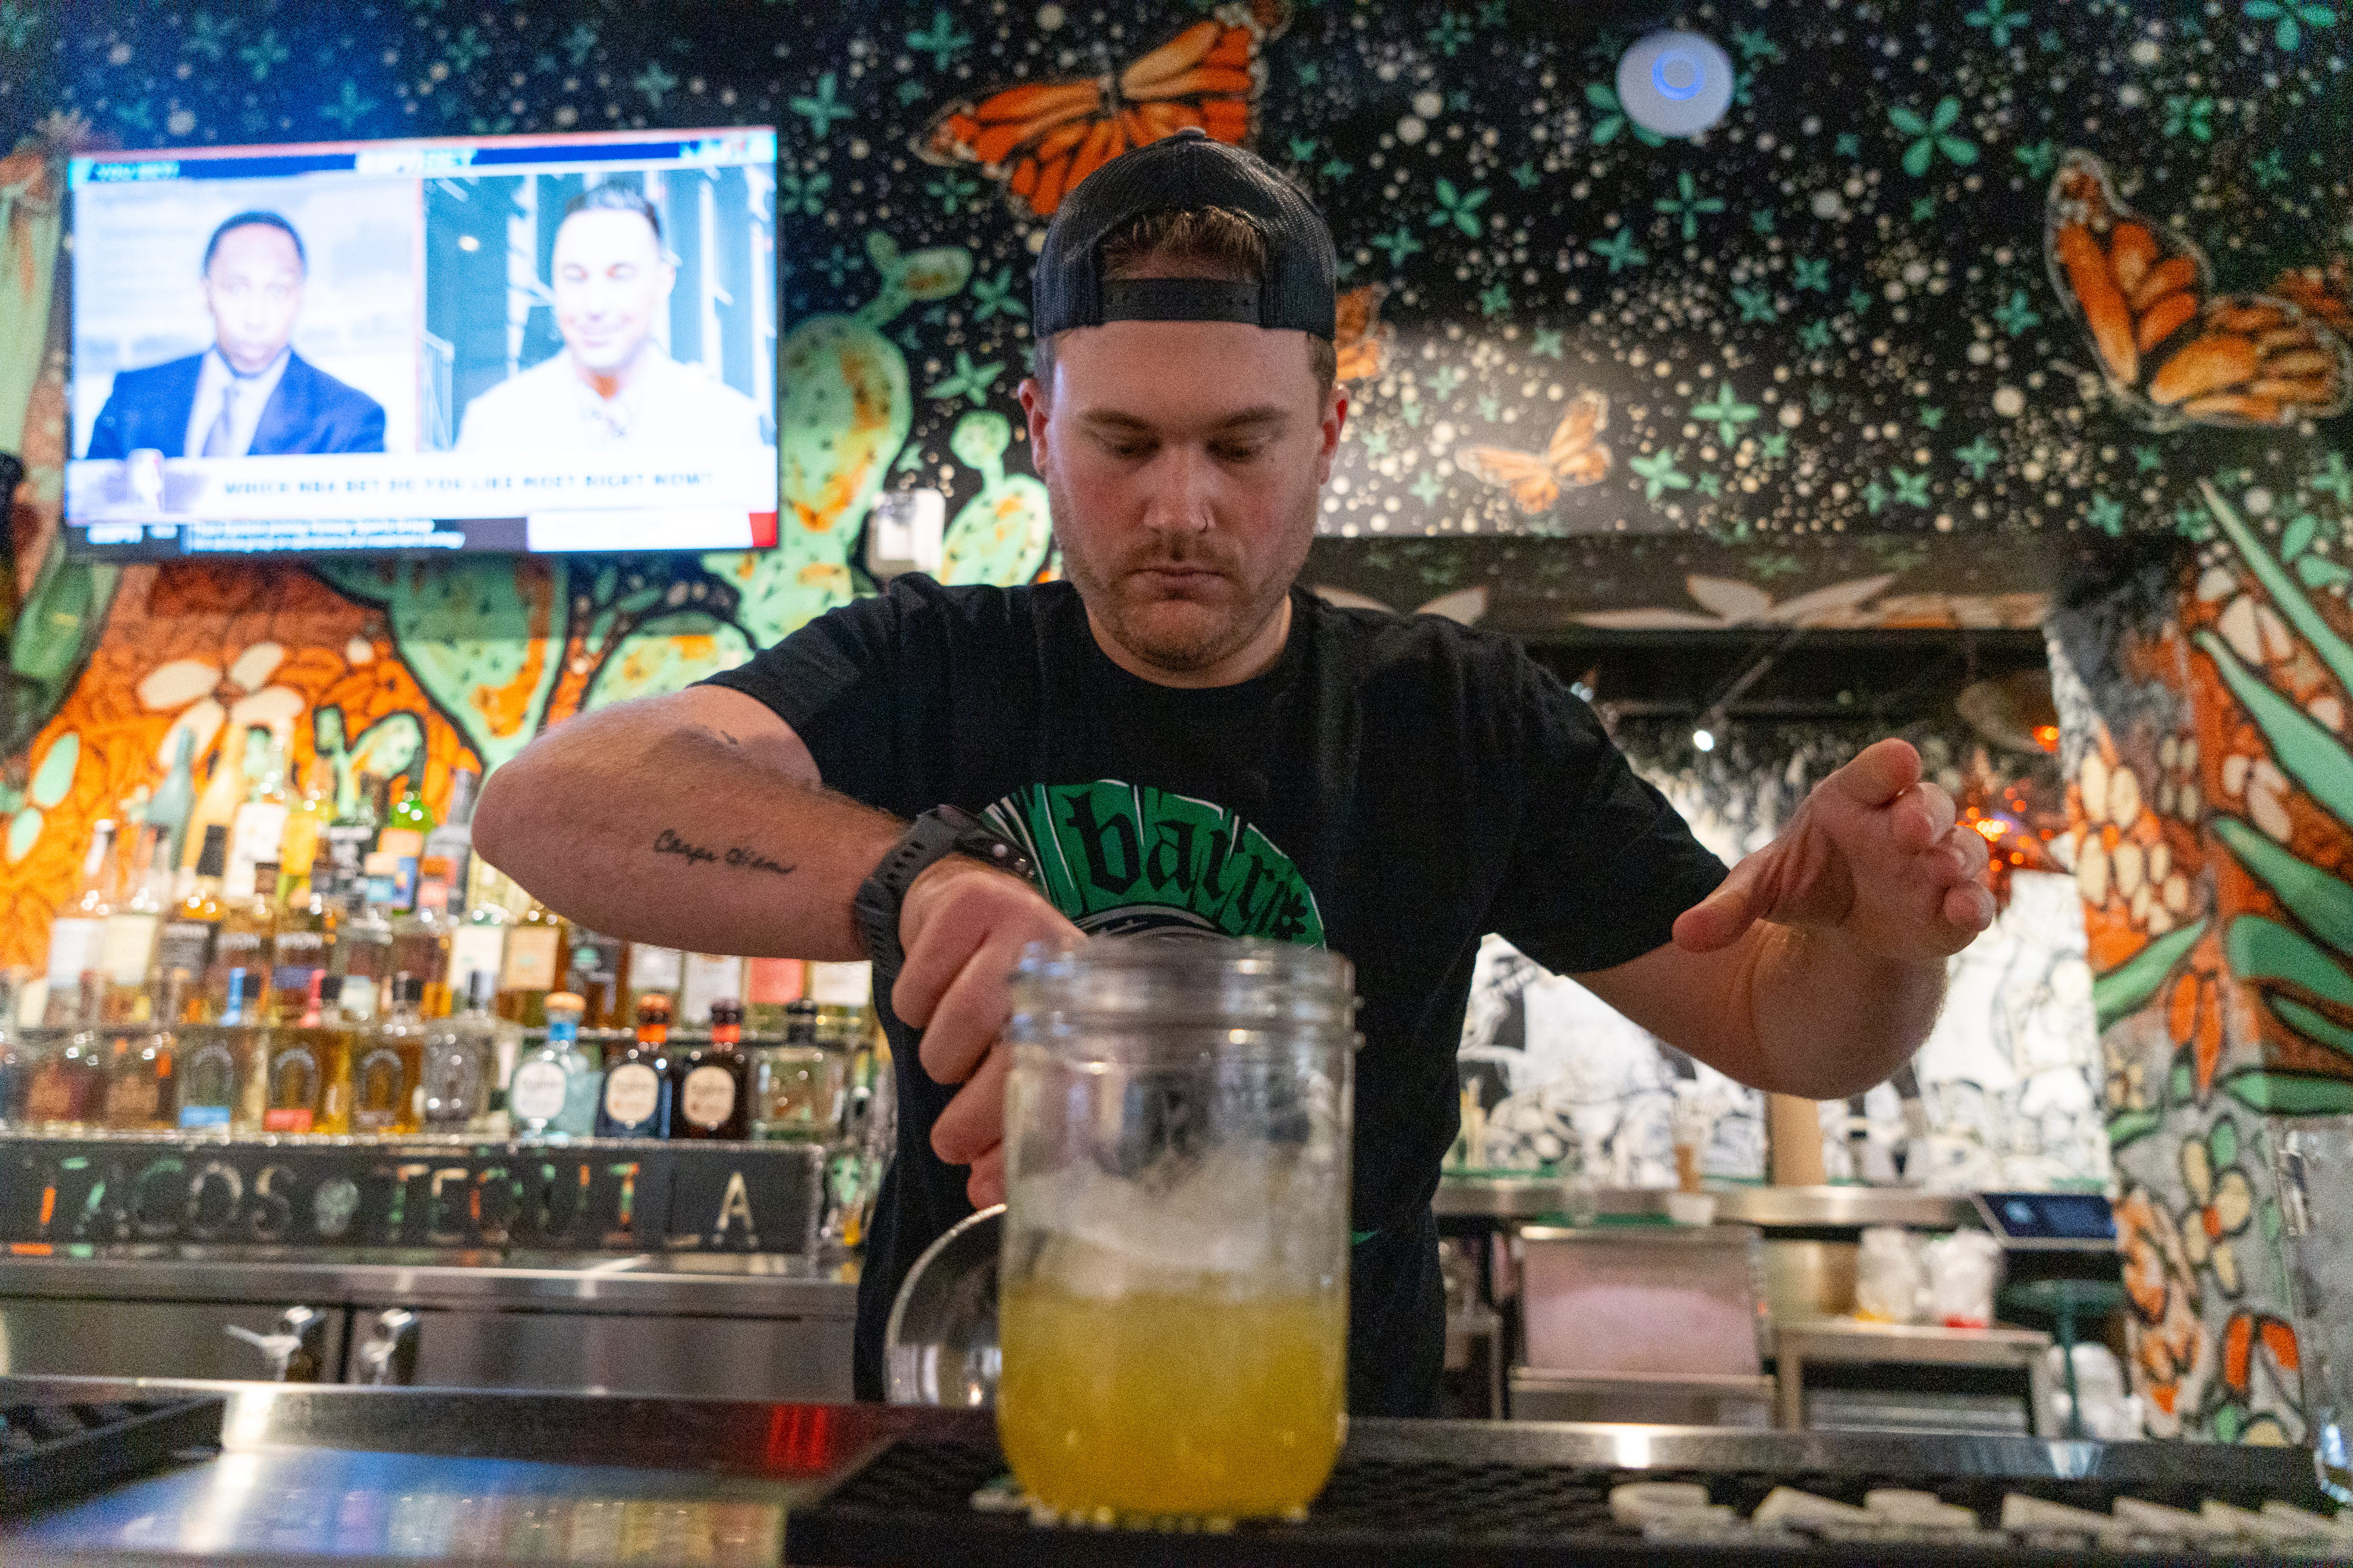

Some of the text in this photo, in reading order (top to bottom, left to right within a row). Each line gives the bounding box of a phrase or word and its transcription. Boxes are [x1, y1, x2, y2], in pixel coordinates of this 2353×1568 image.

[223, 480, 289, 494] WHICH
[298, 480, 335, 493] NBA
[345, 480, 380, 493] BET
[389, 479, 414, 492] DO
[424, 478, 461, 491] YOU
[471, 477, 512, 490] LIKE
[523, 475, 575, 488] MOST
[584, 474, 644, 486] RIGHT
